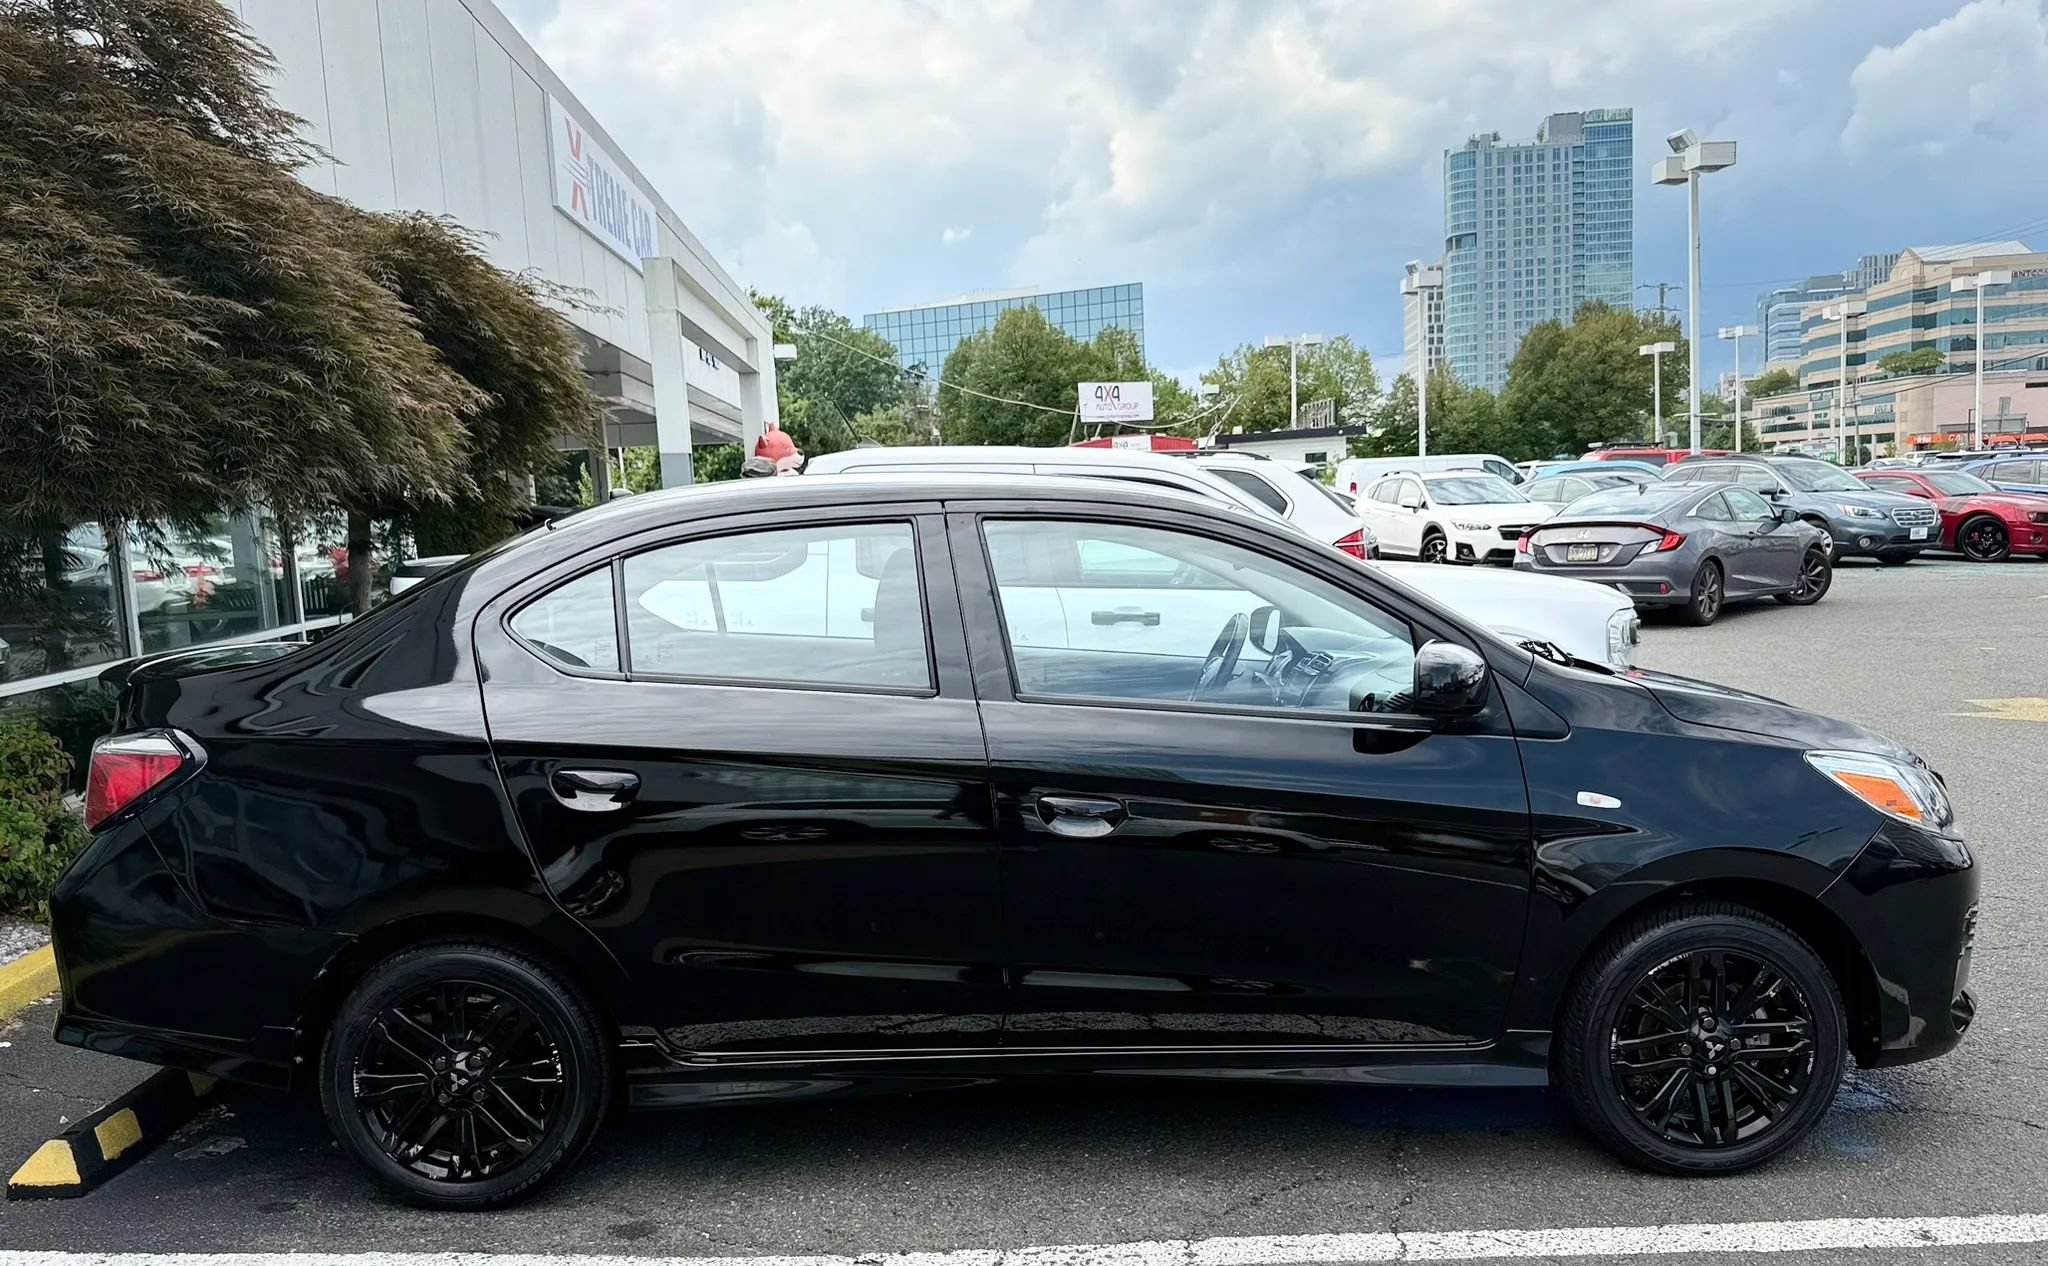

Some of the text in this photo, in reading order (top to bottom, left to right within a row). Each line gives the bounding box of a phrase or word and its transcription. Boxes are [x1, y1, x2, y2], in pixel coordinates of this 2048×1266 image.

[631, 197, 653, 257] CAR
[1096, 402, 1139, 411] AUTO GROUP
